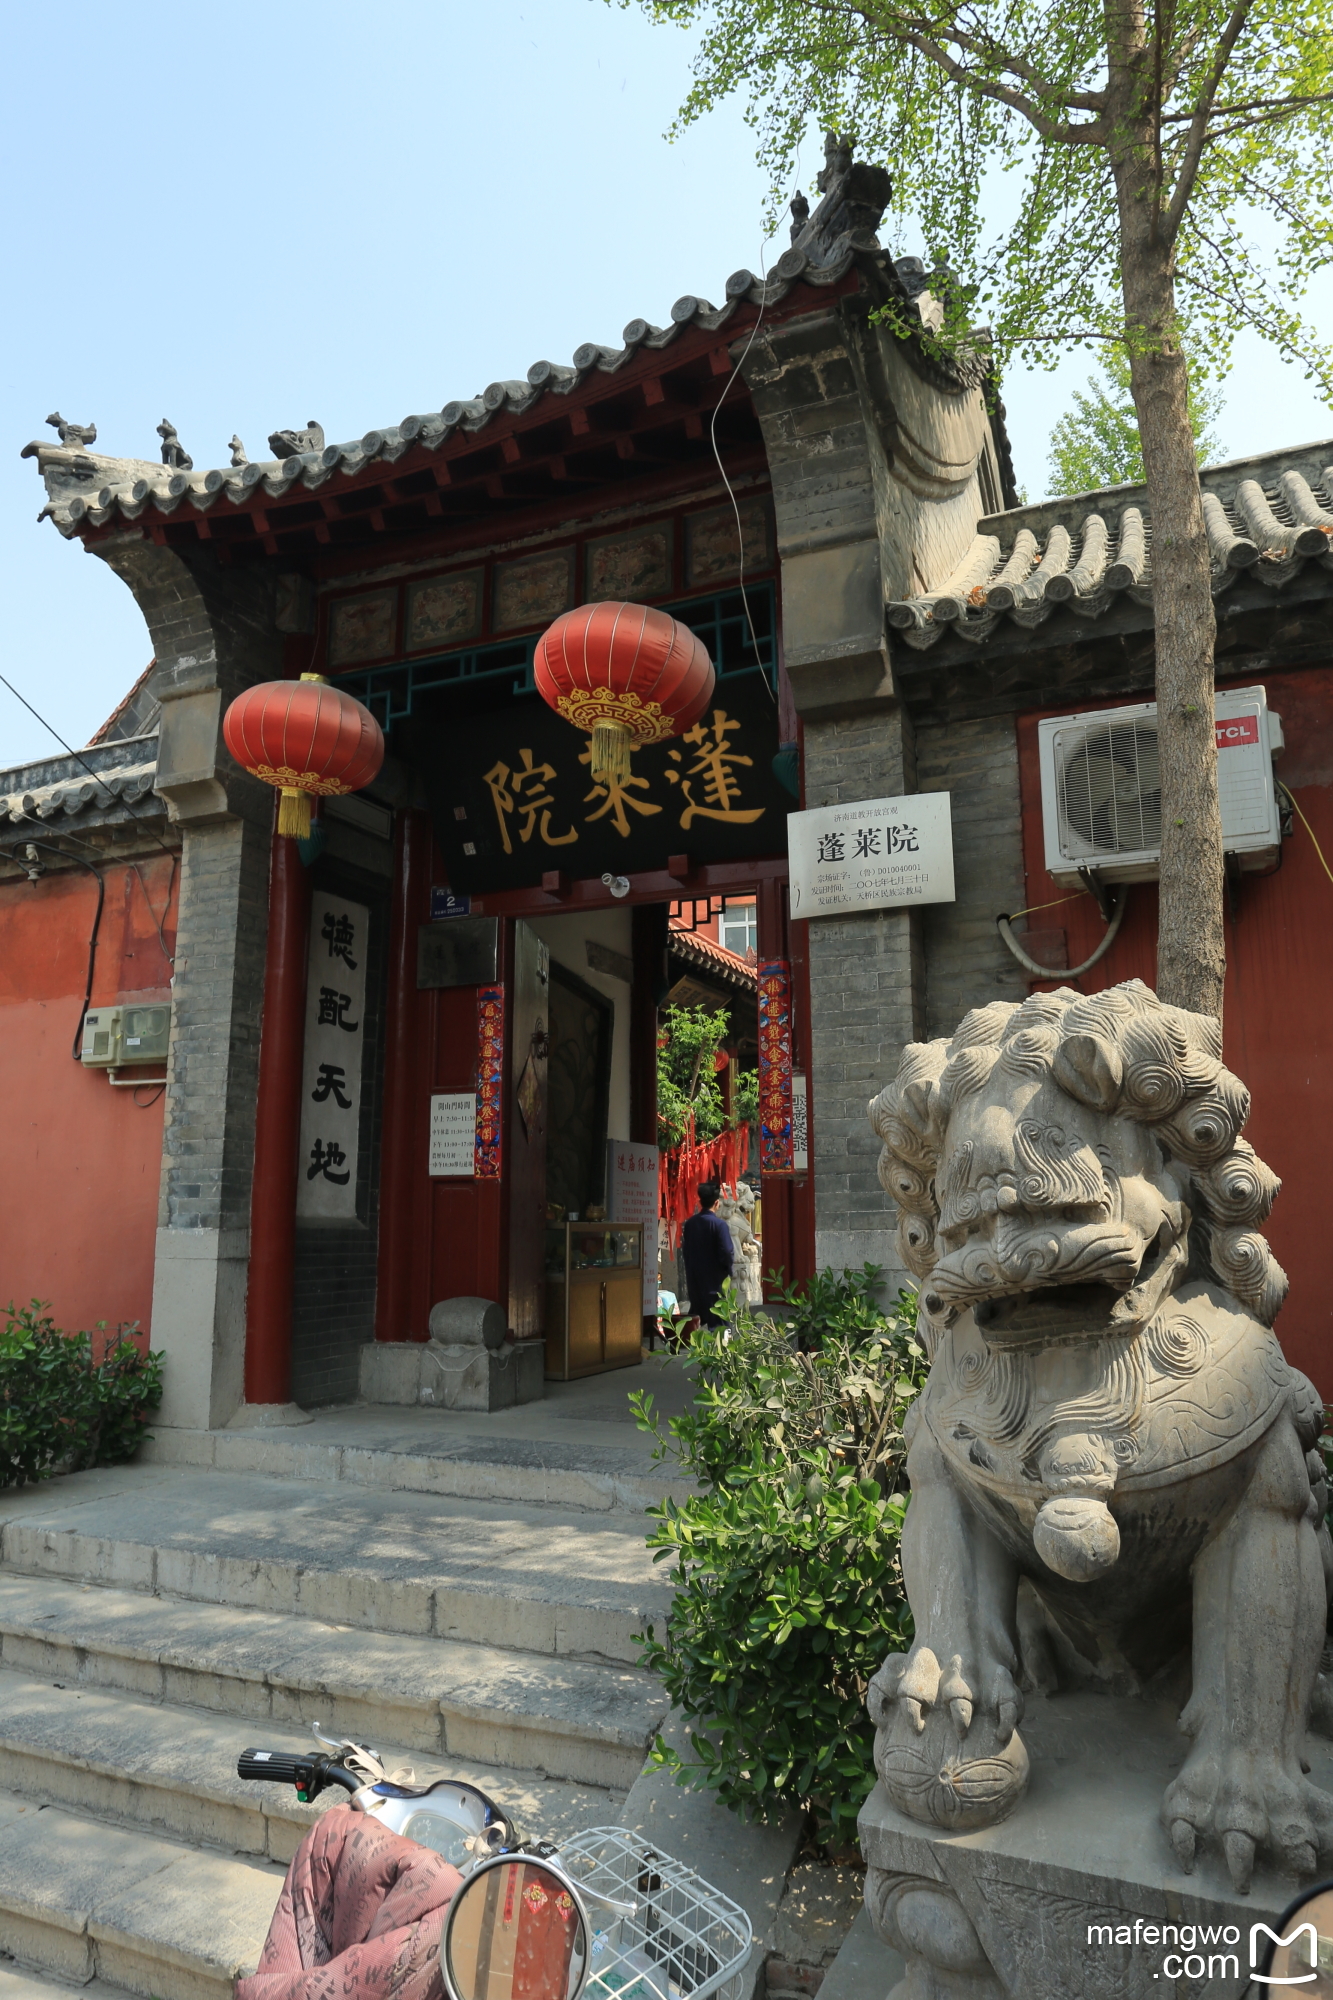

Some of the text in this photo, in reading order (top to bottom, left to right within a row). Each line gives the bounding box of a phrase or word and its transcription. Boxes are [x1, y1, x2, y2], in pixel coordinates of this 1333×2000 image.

[1215, 725, 1251, 740] TCL
[834, 806, 899, 822] 济南道教开放宫观
[817, 823, 920, 864] 蓬莱院
[446, 895, 456, 907] 2
